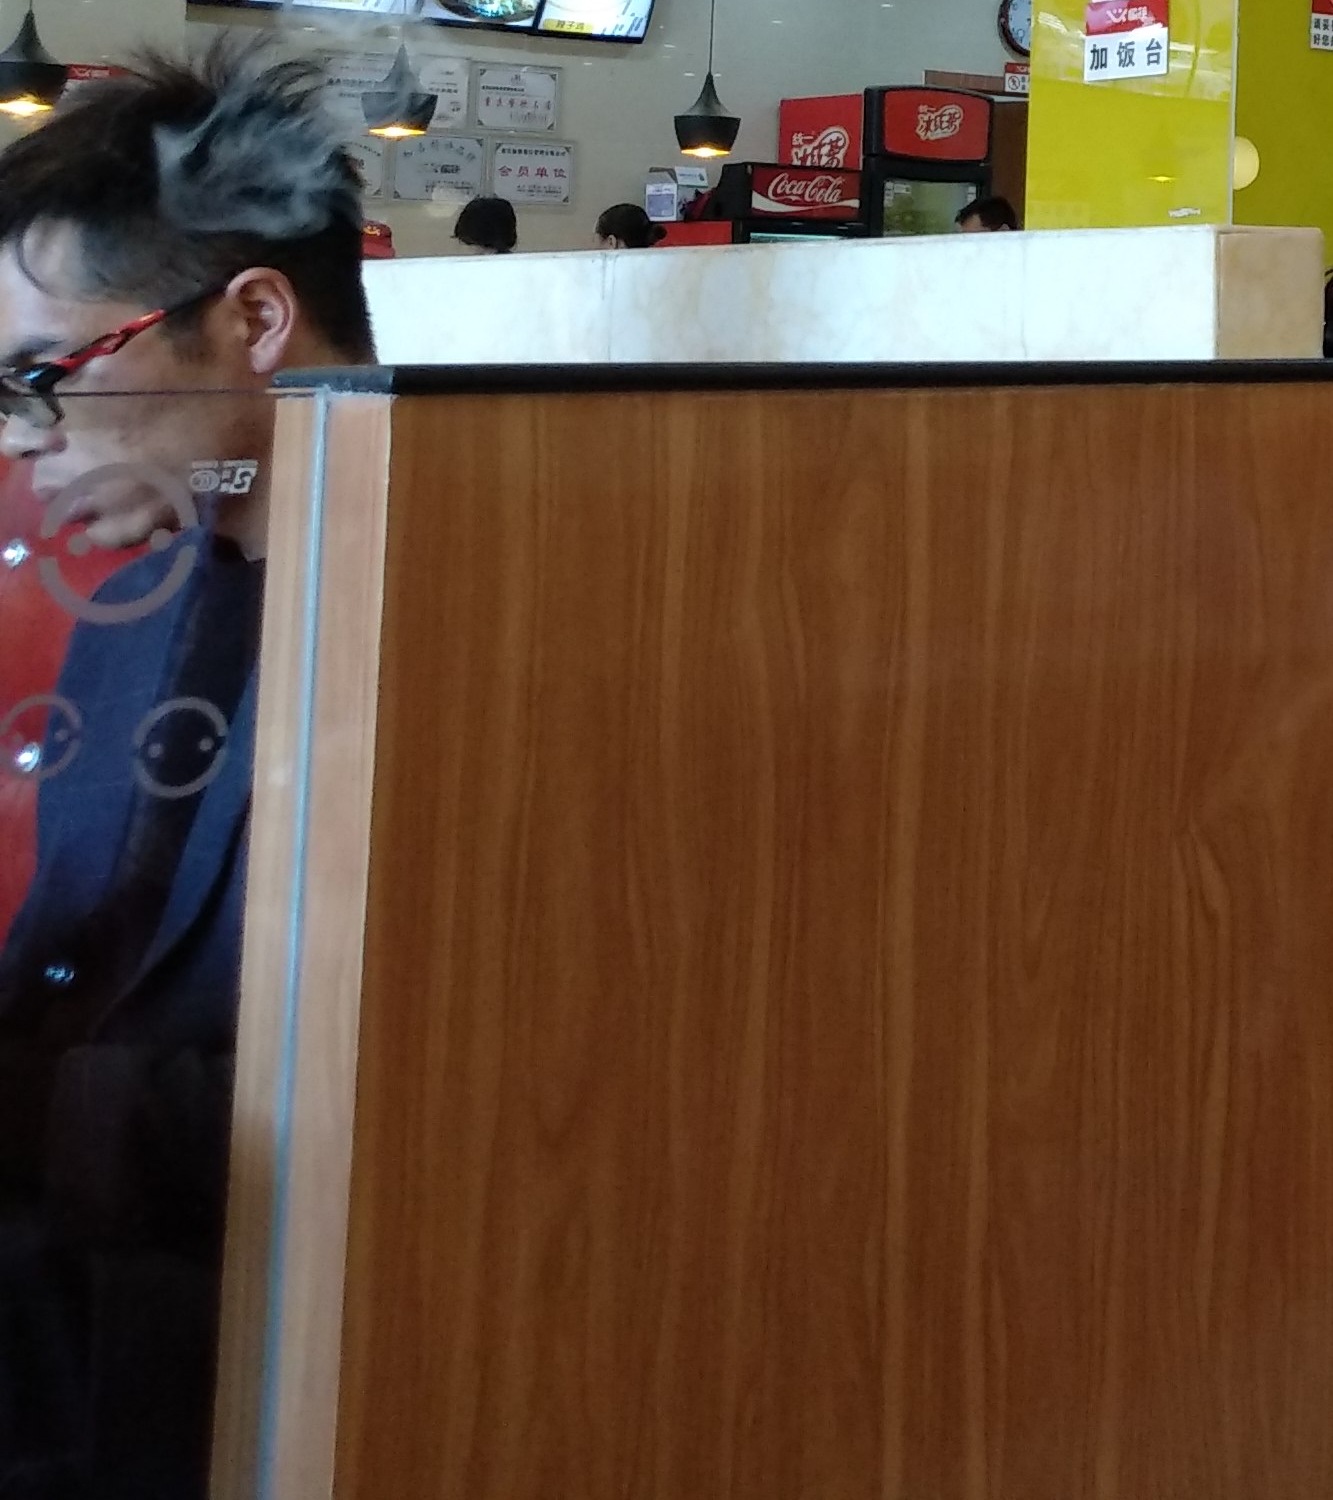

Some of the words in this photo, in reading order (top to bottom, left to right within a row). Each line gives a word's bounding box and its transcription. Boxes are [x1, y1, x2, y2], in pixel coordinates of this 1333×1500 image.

[1090, 38, 1162, 71] 加饭台
[792, 132, 813, 145] 统一
[499, 165, 567, 179] 会员单位
[768, 172, 845, 203] Coca-Cola
